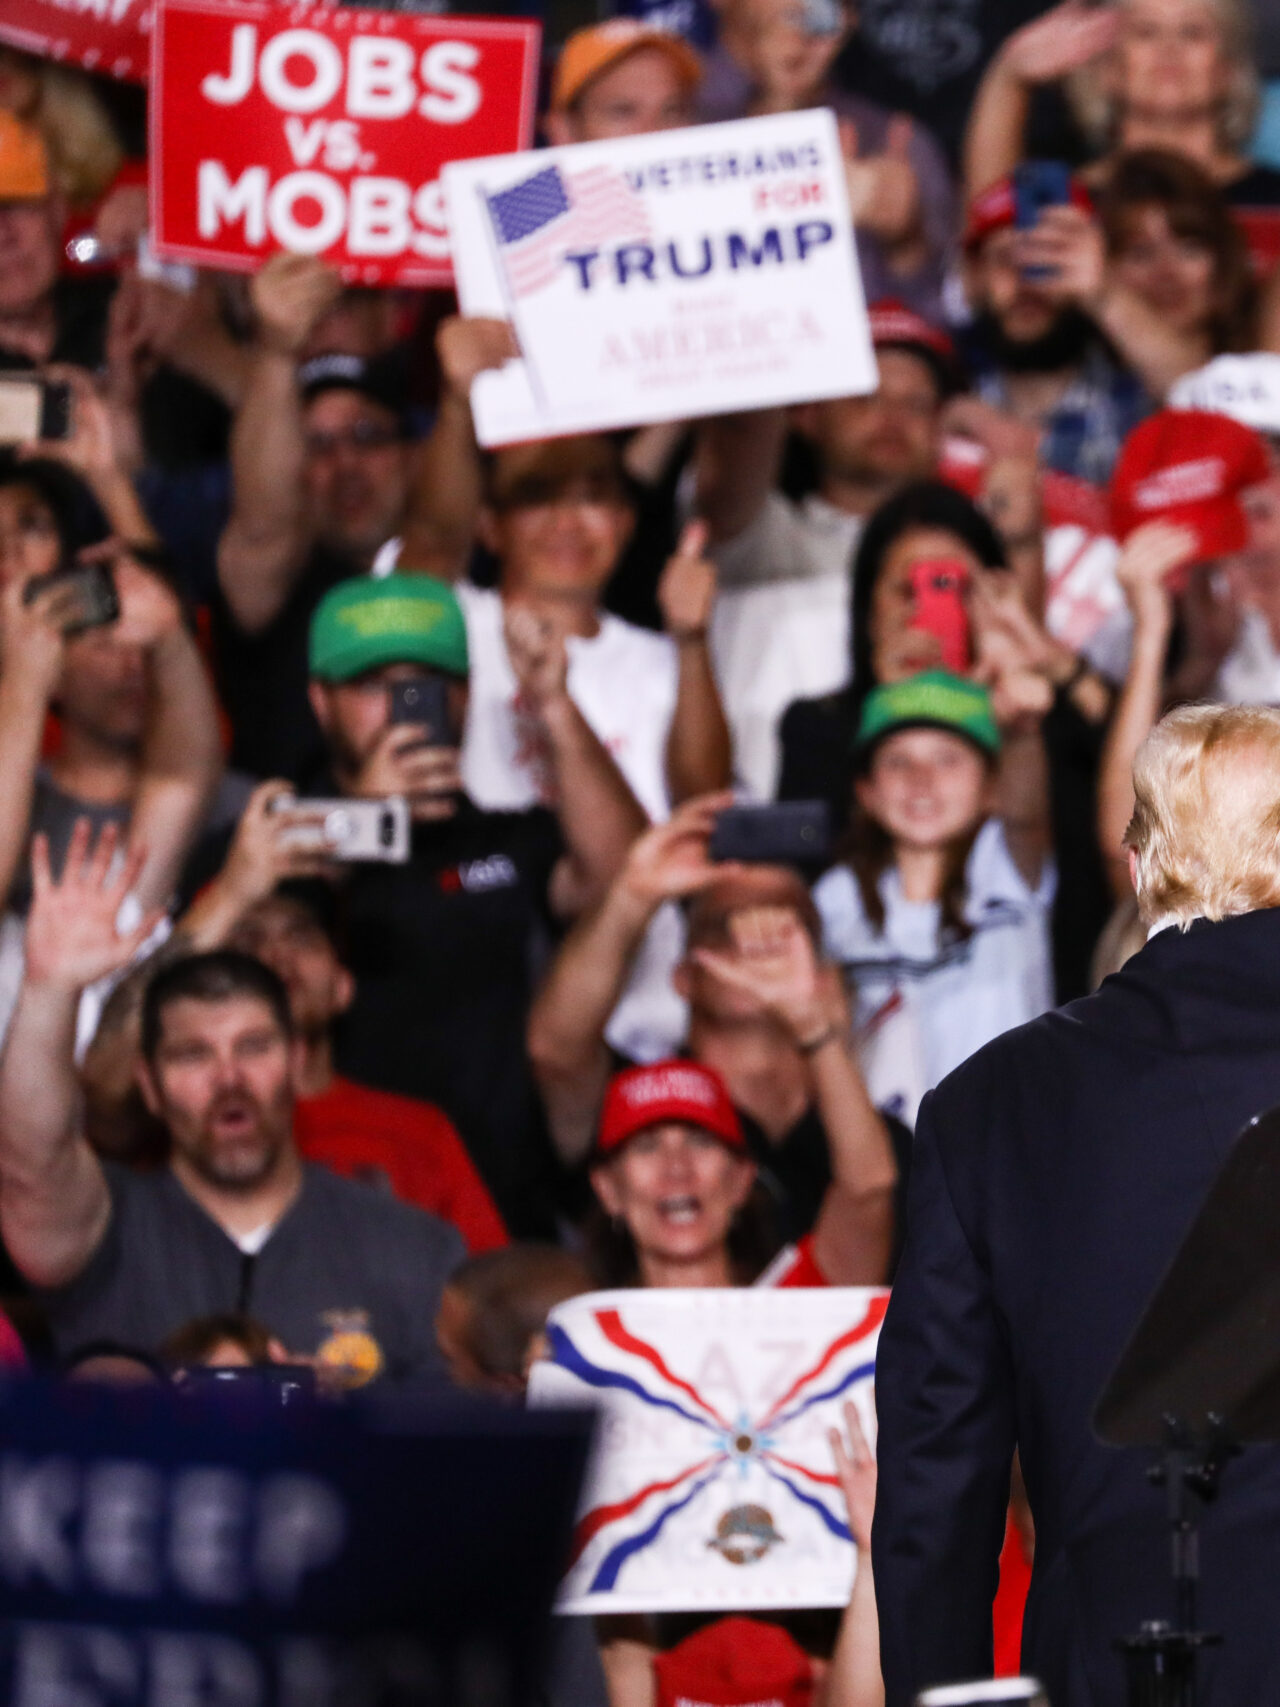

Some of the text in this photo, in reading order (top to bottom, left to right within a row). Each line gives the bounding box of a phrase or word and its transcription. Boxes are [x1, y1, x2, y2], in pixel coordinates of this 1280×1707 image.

[201, 23, 482, 125] JOBS
[284, 116, 376, 171] VS.
[623, 140, 822, 192] VETERANS
[197, 159, 452, 258] MOBS
[753, 179, 827, 213] FOR
[563, 220, 834, 290] TRUMP
[0, 1452, 348, 1606] KEEP
